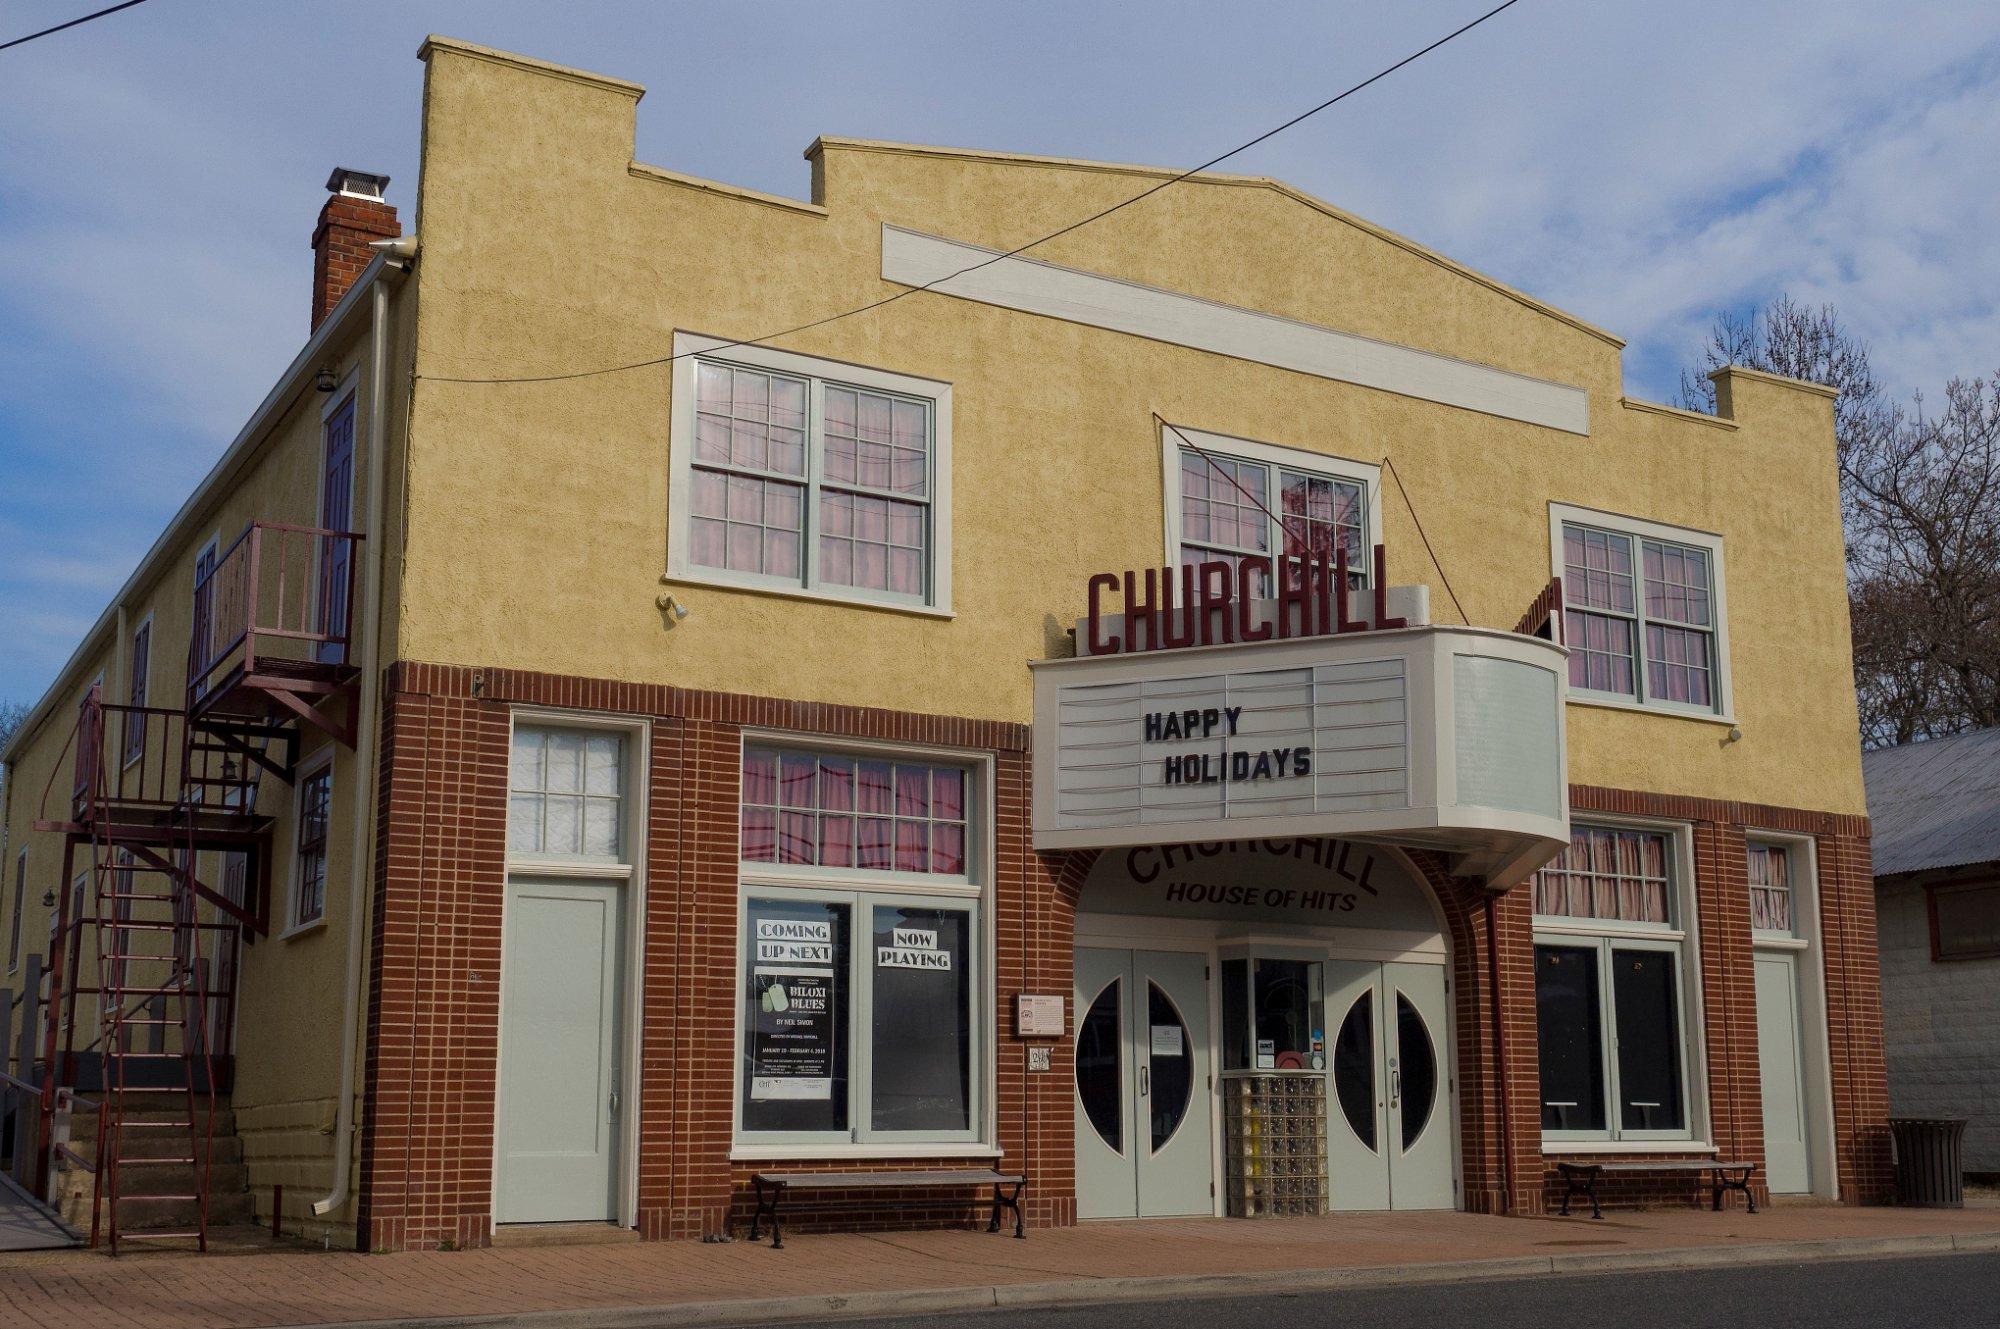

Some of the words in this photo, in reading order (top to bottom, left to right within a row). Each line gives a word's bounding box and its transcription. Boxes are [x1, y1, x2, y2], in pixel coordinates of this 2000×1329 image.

[1088, 544, 1407, 655] CHURCHILL
[1145, 706, 1242, 741] HAPPY
[1165, 746, 1311, 784] HOLIDAYS
[1166, 882, 1260, 907] HOUSE
[1264, 888, 1297, 908] OF
[1301, 890, 1357, 912] HITS
[760, 923, 827, 939] COMING
[897, 932, 932, 947] NOW
[762, 945, 785, 958] UP
[789, 946, 831, 960] NEXT
[880, 951, 949, 967] PLAYING
[790, 986, 826, 997] BILOXI
[791, 999, 825, 1009] BLUES
